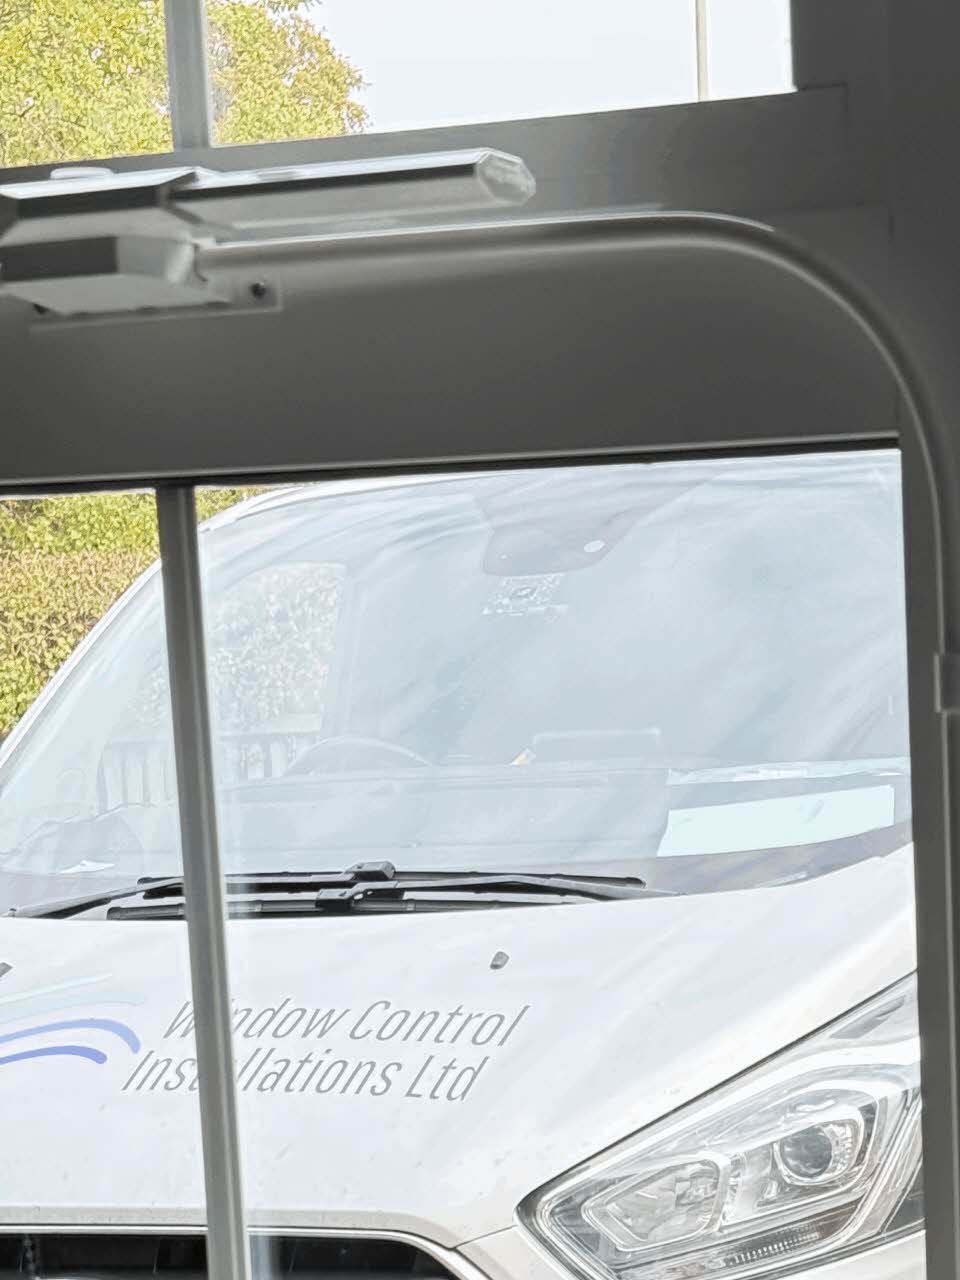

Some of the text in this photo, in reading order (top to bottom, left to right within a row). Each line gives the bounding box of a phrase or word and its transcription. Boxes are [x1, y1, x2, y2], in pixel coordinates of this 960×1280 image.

[163, 998, 532, 1046] Wndow Control
[122, 1048, 488, 1102] Insllations Ltd
